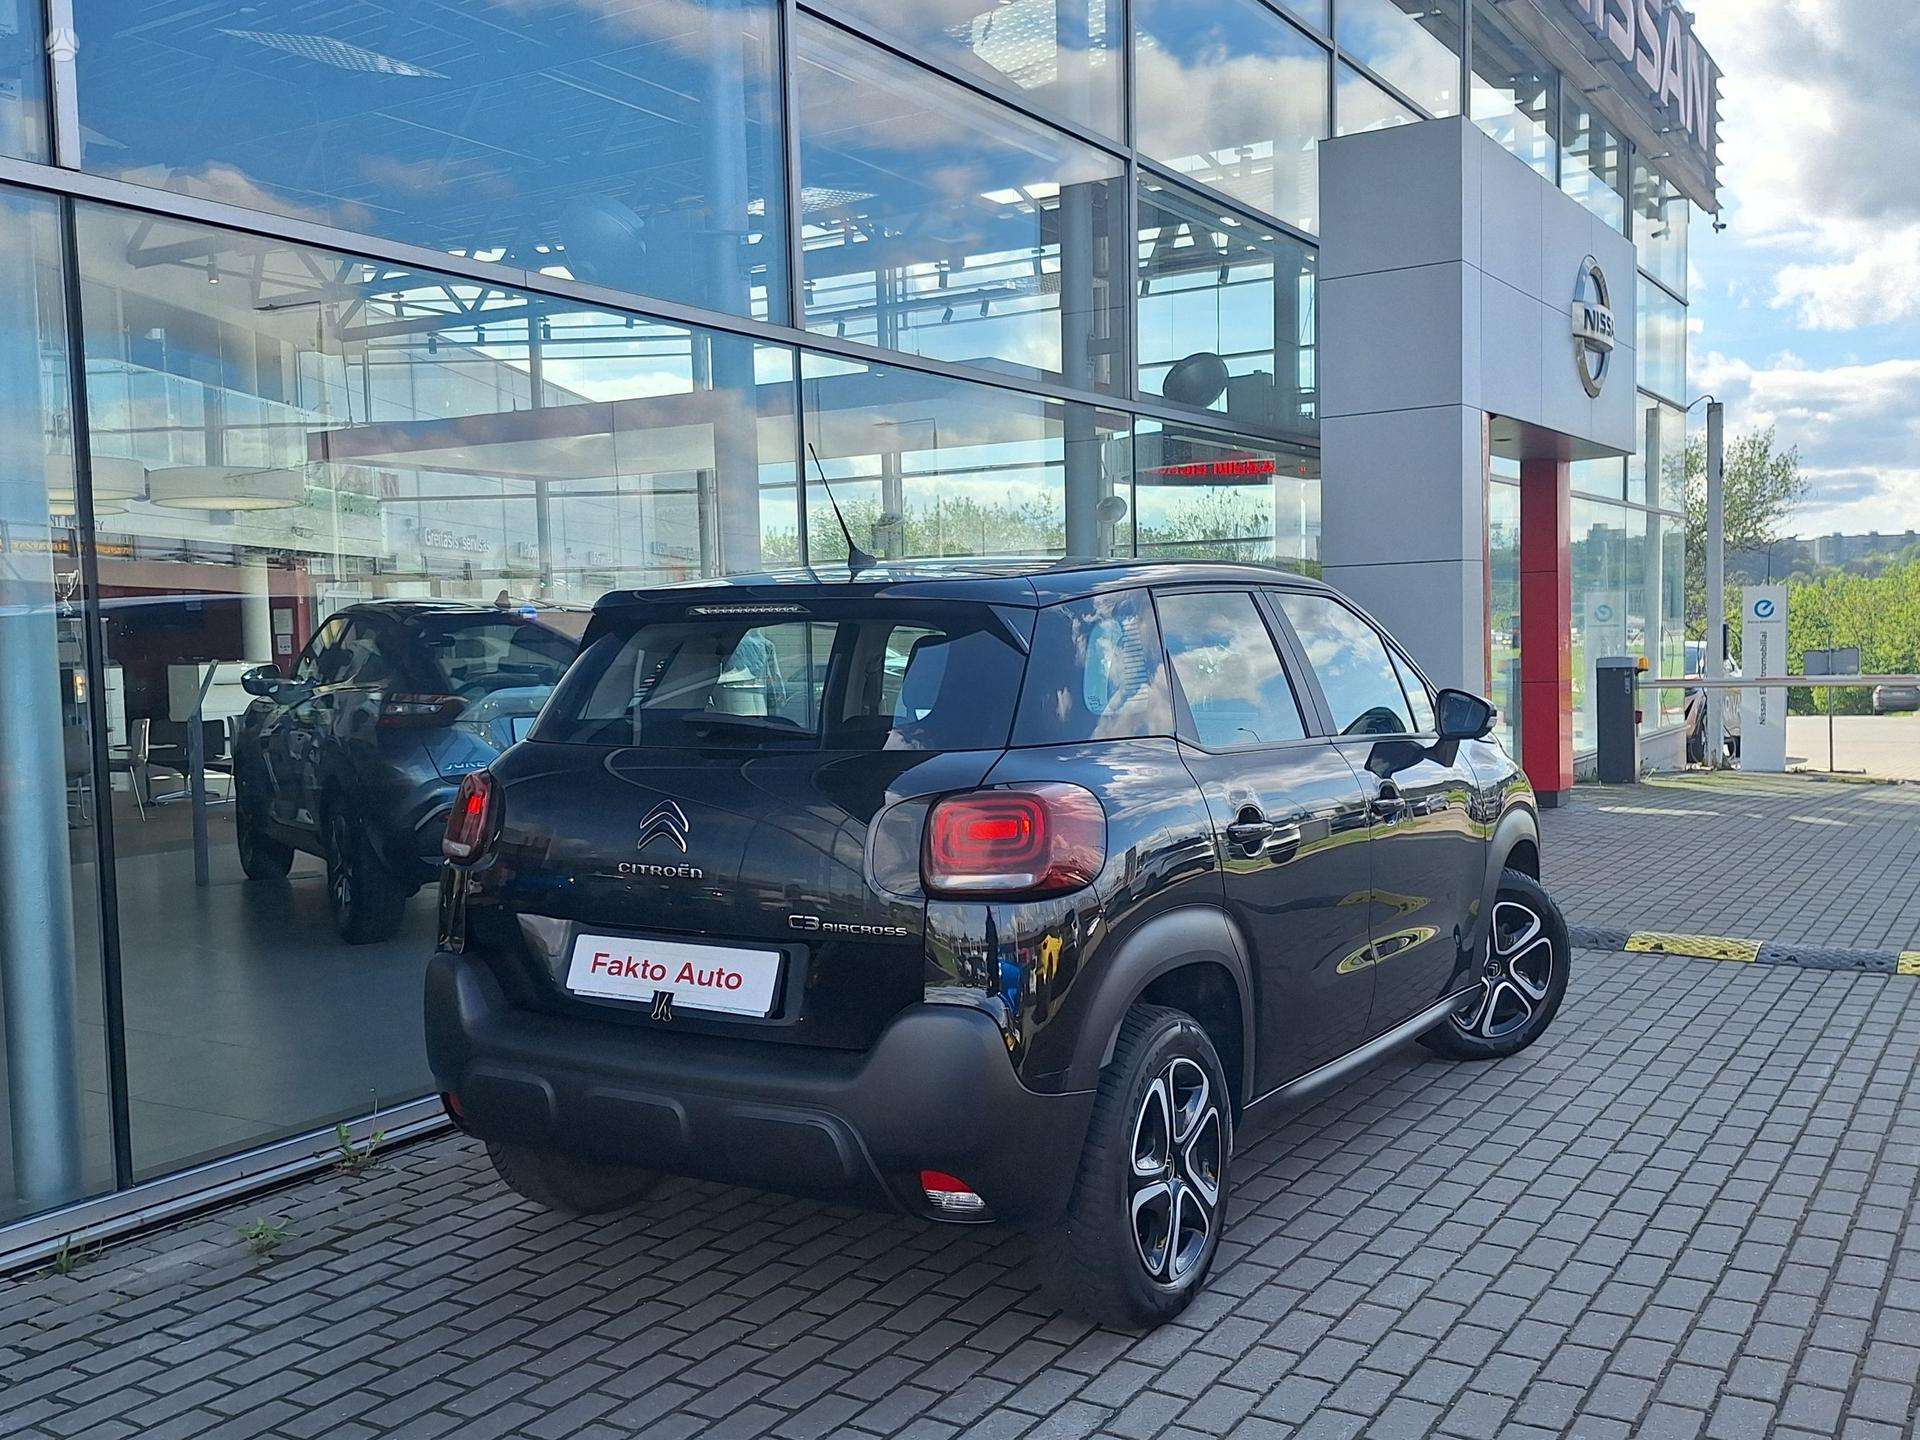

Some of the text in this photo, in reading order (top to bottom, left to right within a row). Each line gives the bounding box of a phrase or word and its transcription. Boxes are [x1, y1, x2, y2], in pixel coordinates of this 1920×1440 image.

[1577, 0, 1710, 150] SSAN
[1584, 308, 1614, 337] NISS
[1759, 631, 1768, 695] Eltromobiliai
[788, 914, 908, 936] C3 AIRCROSS
[591, 952, 743, 990] Fakto Auto
